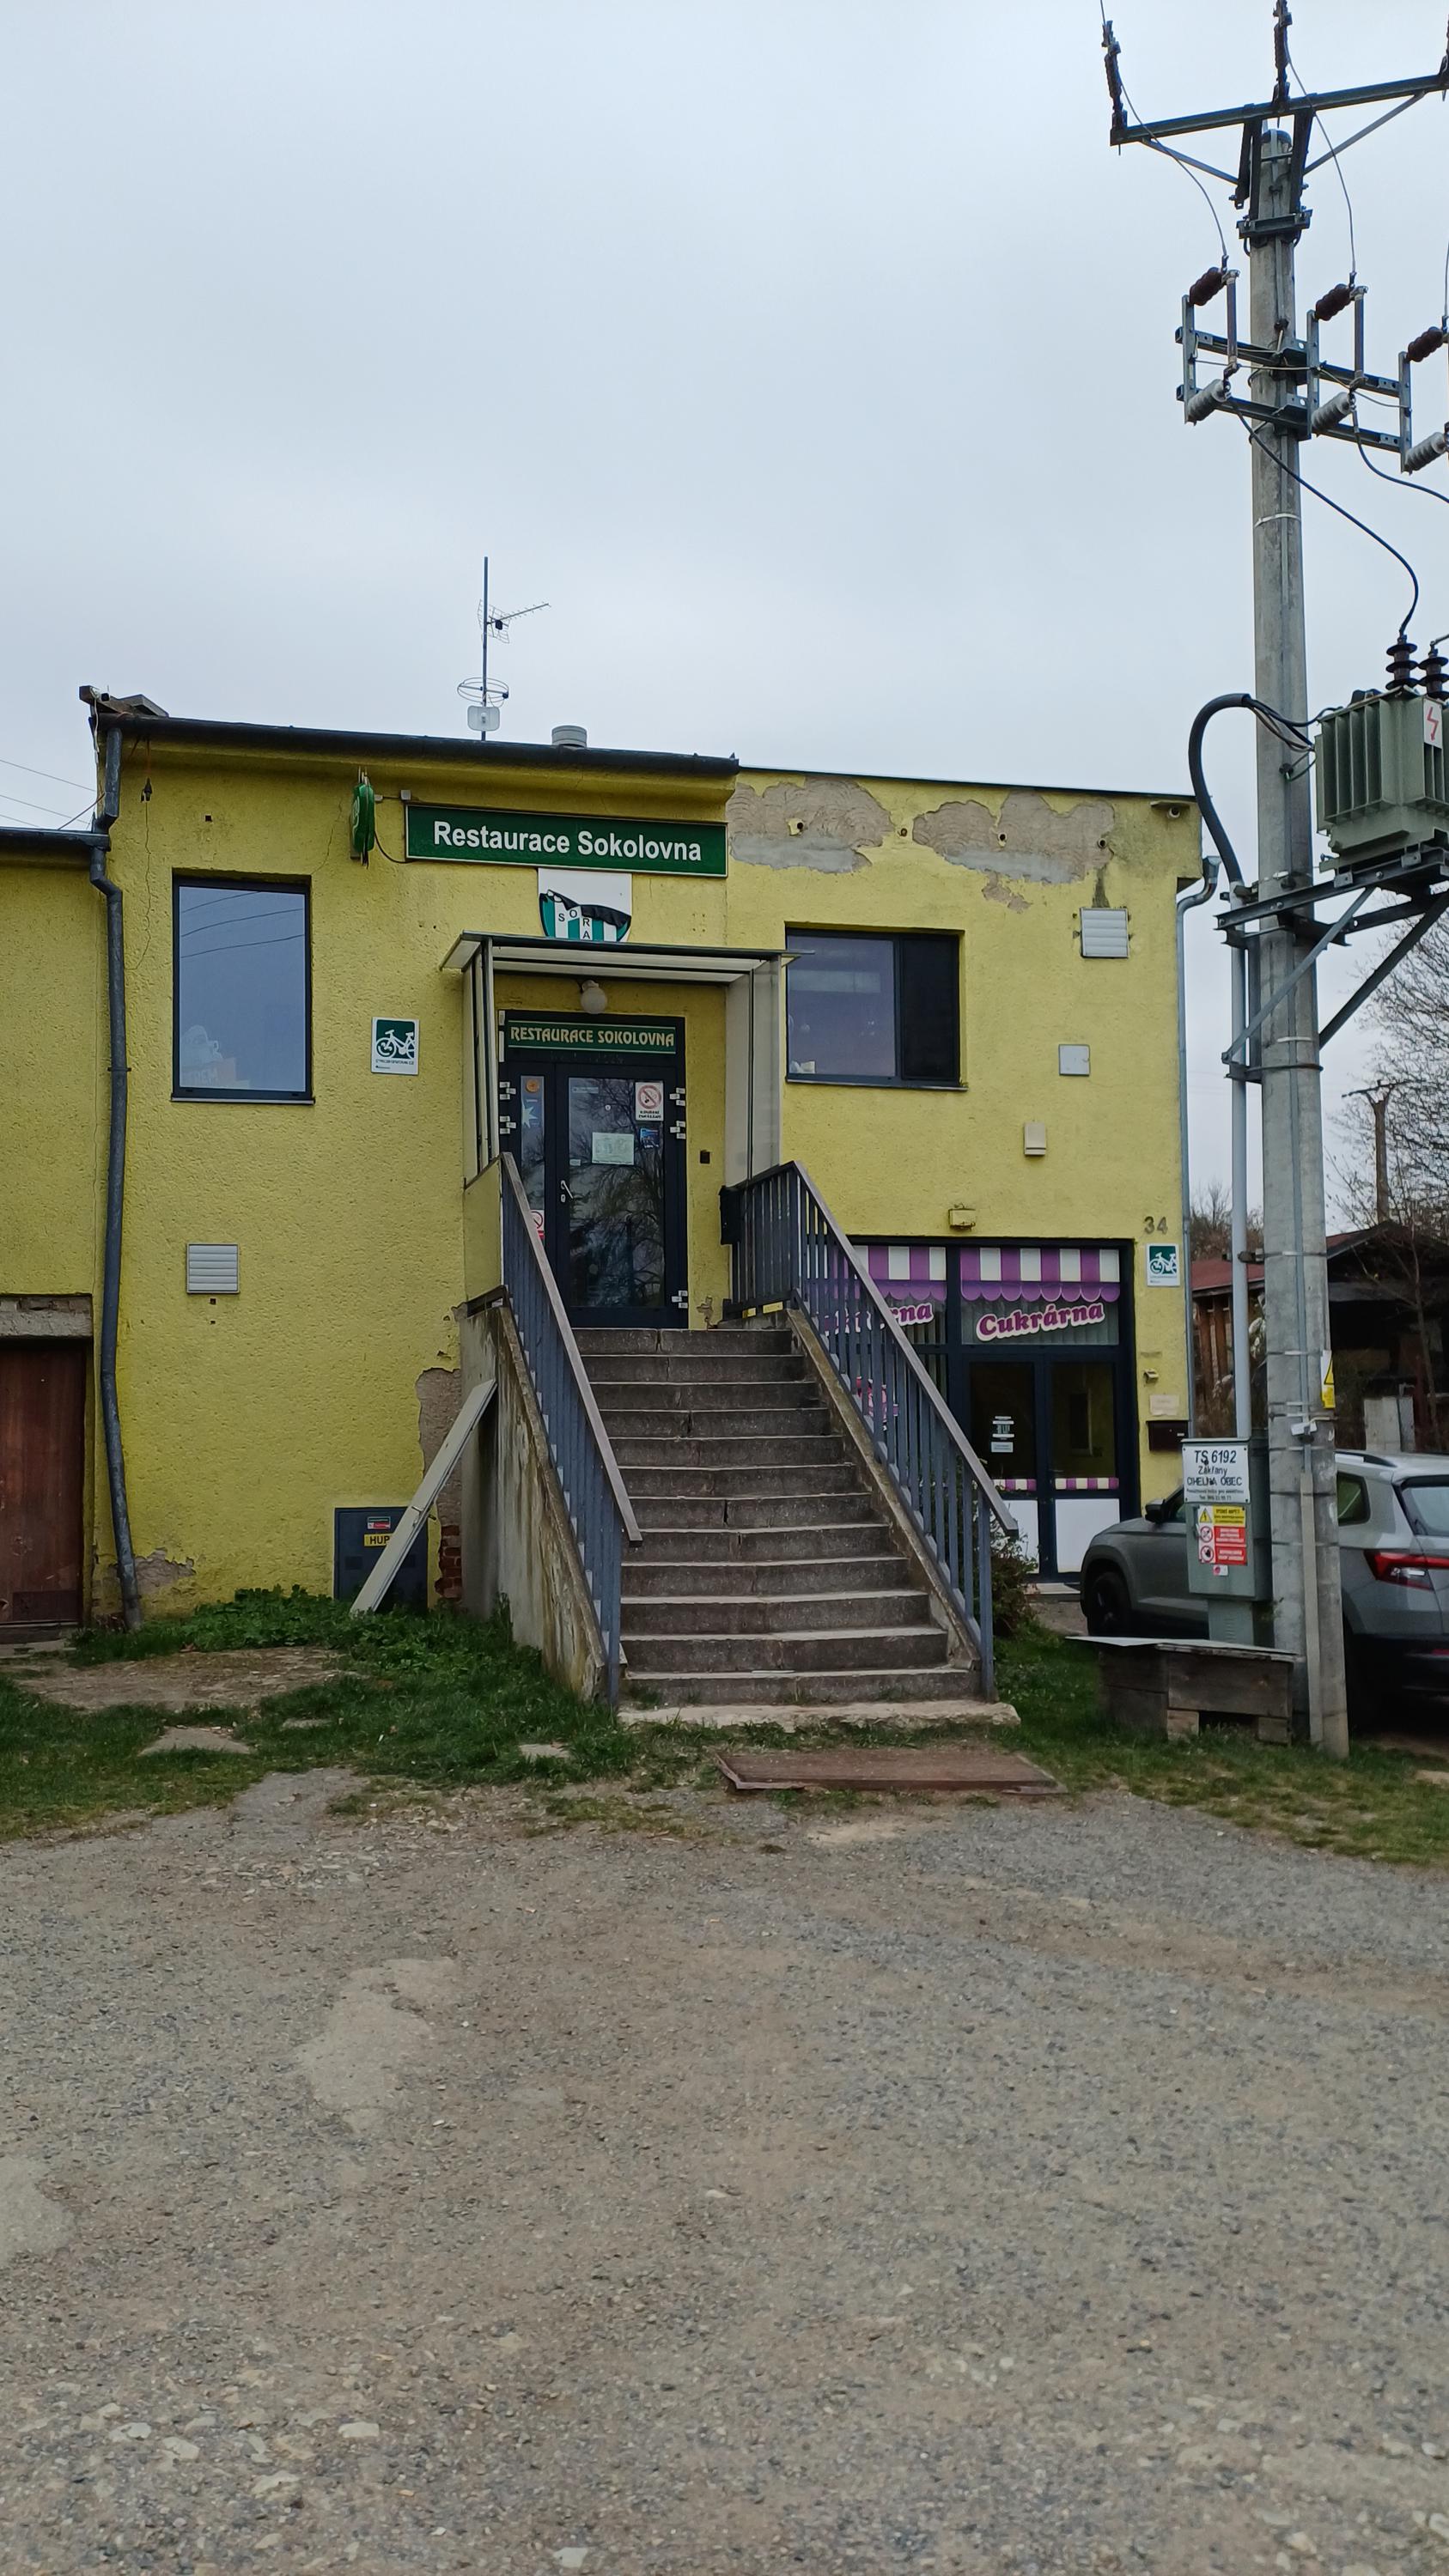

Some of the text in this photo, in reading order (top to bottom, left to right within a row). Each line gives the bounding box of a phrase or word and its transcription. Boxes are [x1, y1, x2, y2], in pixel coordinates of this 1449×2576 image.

[433, 820, 702, 861] Restaurace Sokolovna
[510, 1026, 674, 1047] RESTAURACE SOKOLOVNA
[1144, 1216, 1168, 1235] 34
[977, 1303, 1105, 1339] Cukrárna
[1195, 1449, 1237, 1465] TS 6192
[369, 1535, 390, 1545] HUP
